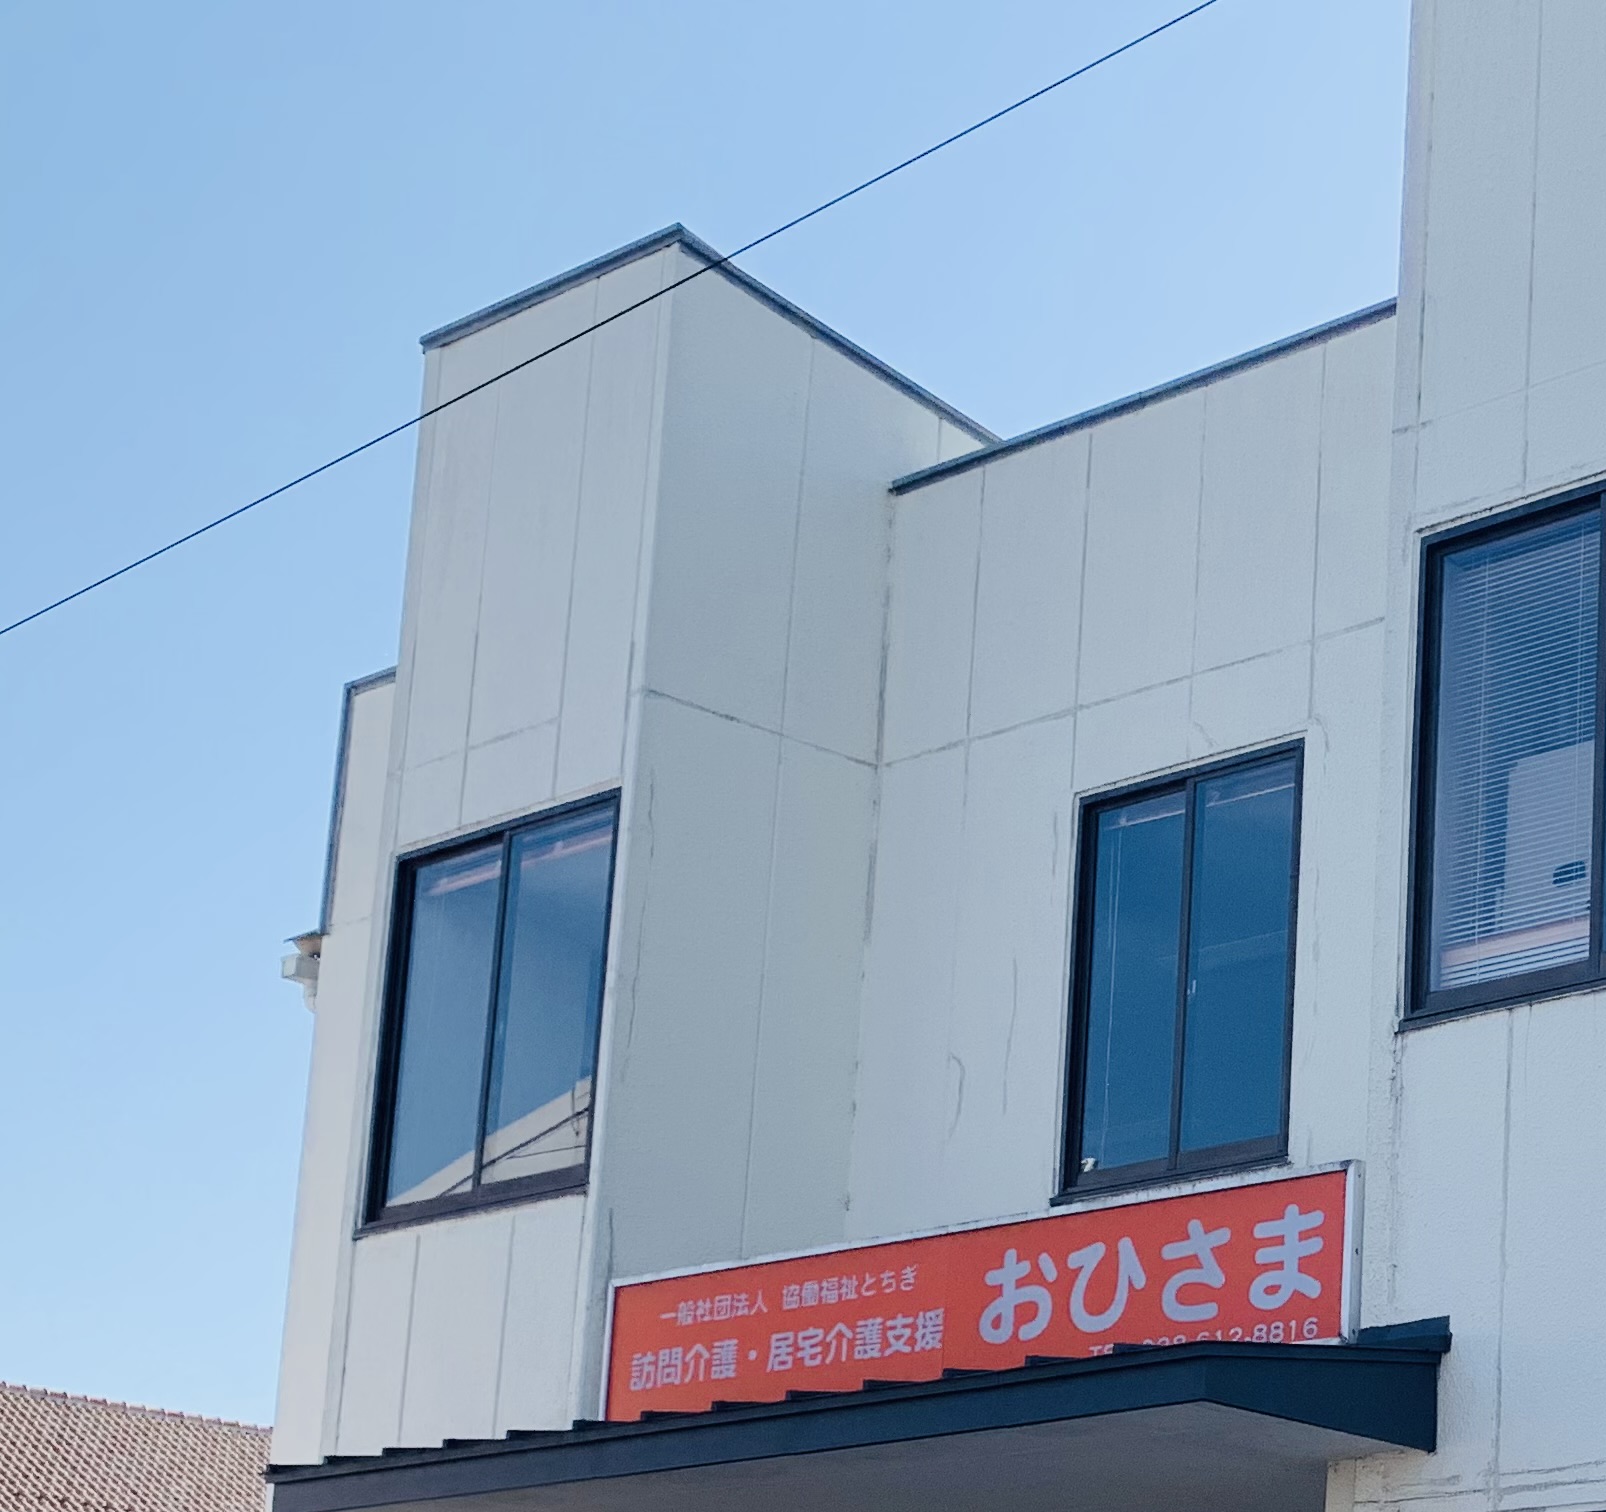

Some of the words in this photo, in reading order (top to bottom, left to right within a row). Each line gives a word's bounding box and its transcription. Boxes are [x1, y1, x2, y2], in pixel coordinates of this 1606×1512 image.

[660, 1290, 768, 1326] 一般社団法人
[782, 1264, 917, 1309] 協働福祉とちぎ
[978, 1203, 1326, 1342] おひさま
[630, 1308, 945, 1391] 訪問介護・居宅介護支援
